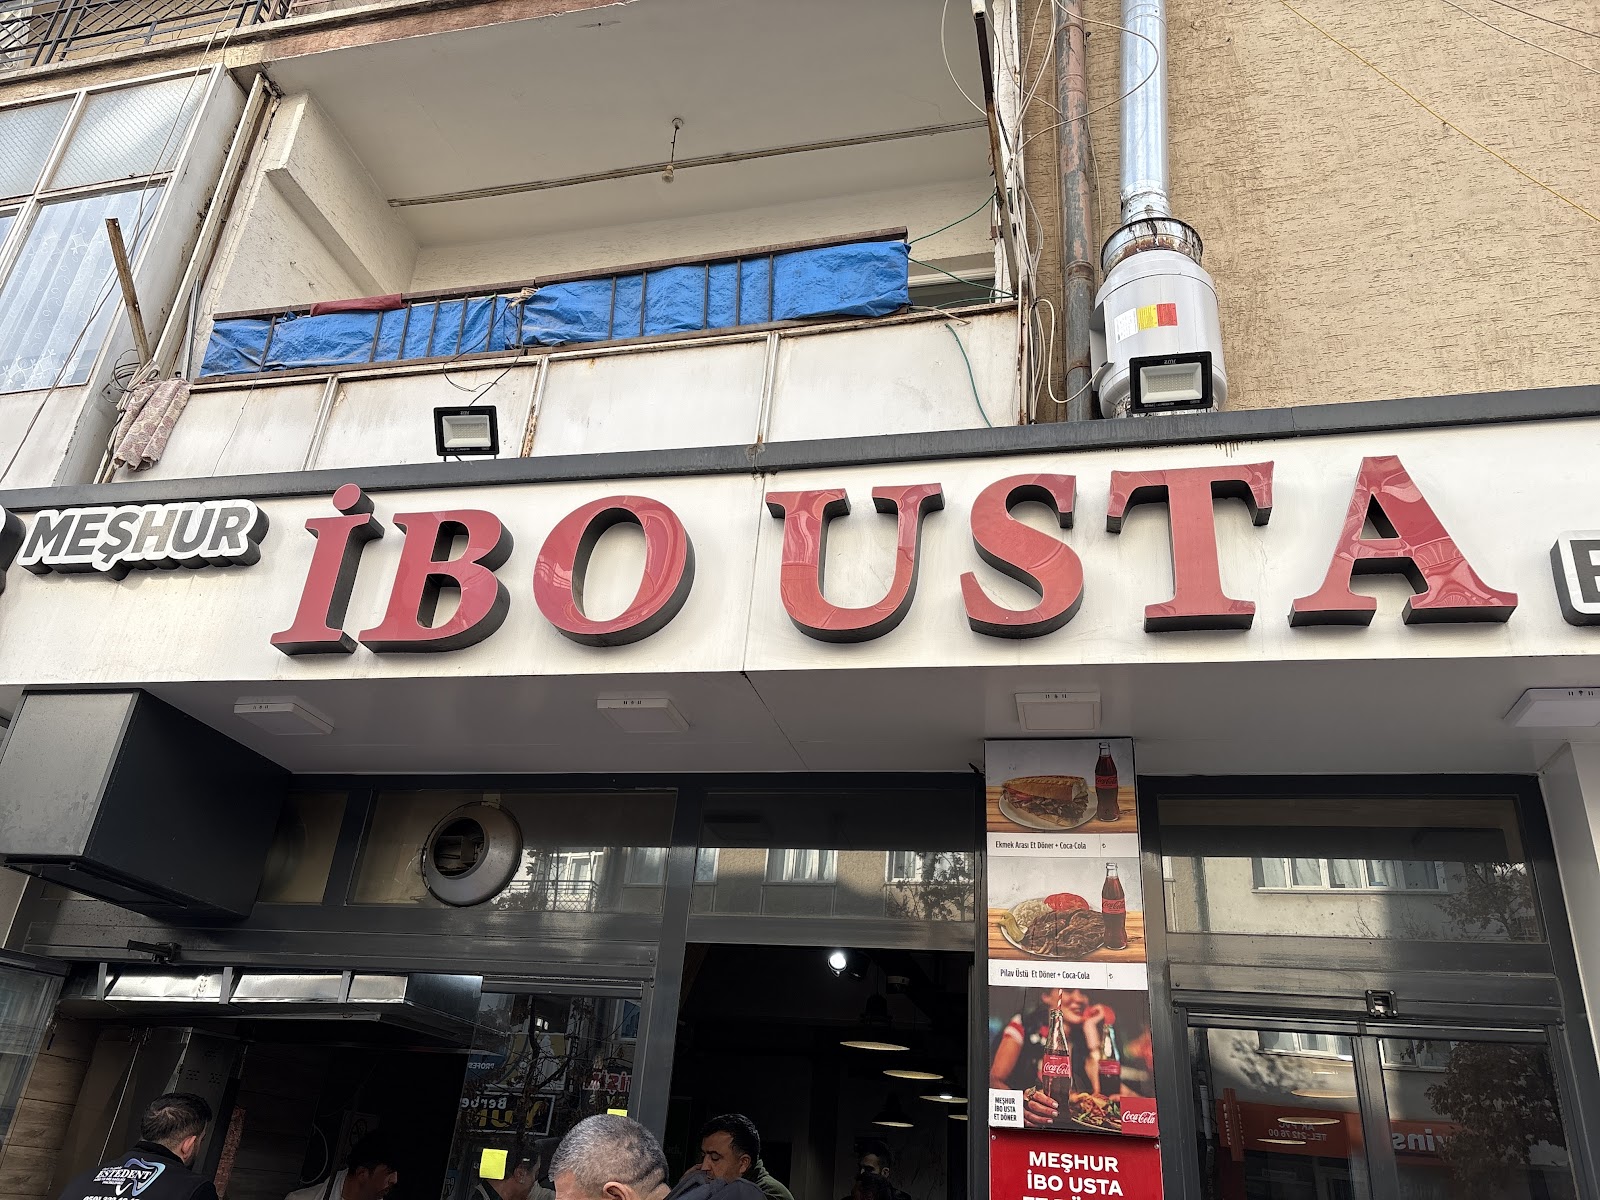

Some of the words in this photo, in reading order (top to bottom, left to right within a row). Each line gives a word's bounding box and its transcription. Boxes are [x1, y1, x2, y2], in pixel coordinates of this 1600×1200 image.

[22, 503, 250, 560] MEŞHUR
[272, 483, 695, 655] İBO
[765, 455, 1518, 644] USTA
[995, 840, 1014, 849] Ekmek
[1015, 841, 1030, 849] Arası
[1037, 841, 1054, 849] Döner
[1059, 841, 1087, 850] Coca-Cola
[1000, 968, 1015, 977] Pilav
[1015, 967, 1029, 978] Üstü
[1031, 970, 1038, 978] Et
[1039, 970, 1056, 979] Döner
[1062, 970, 1090, 980] Coca-Cola
[994, 1096, 1016, 1106] MEŞHUR
[994, 1103, 1004, 1113] İBO
[1003, 1105, 1017, 1114] USTA
[993, 1113, 1000, 1121] ET
[1000, 1113, 1018, 1122] DÖNER
[1122, 1110, 1157, 1125] Coca-Cola
[1029, 1150, 1119, 1174] MEŞHUR
[95, 1168, 152, 1180] ESTEDENT
[1027, 1169, 1064, 1192] İBO
[1068, 1176, 1124, 1197] USTA
